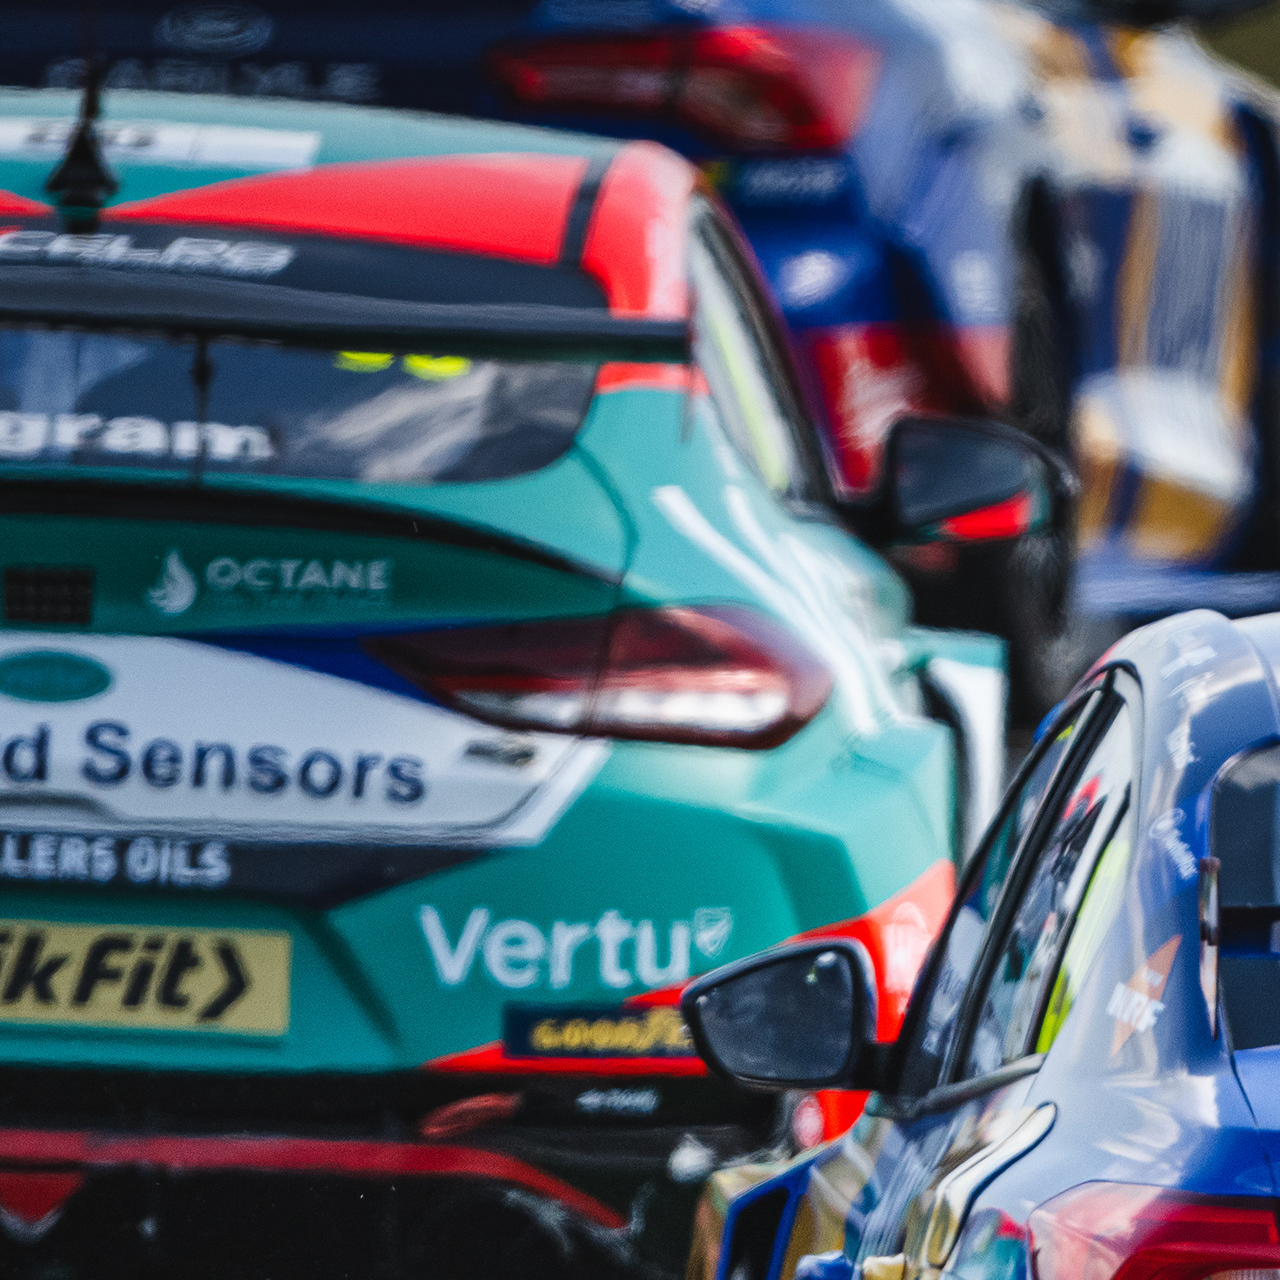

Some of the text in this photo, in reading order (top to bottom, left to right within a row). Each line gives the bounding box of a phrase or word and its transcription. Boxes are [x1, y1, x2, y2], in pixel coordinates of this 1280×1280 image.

[206, 557, 392, 592] OCTANE
[82, 719, 427, 804] Sensors
[125, 835, 233, 888] OILS
[419, 907, 690, 990] Vertu
